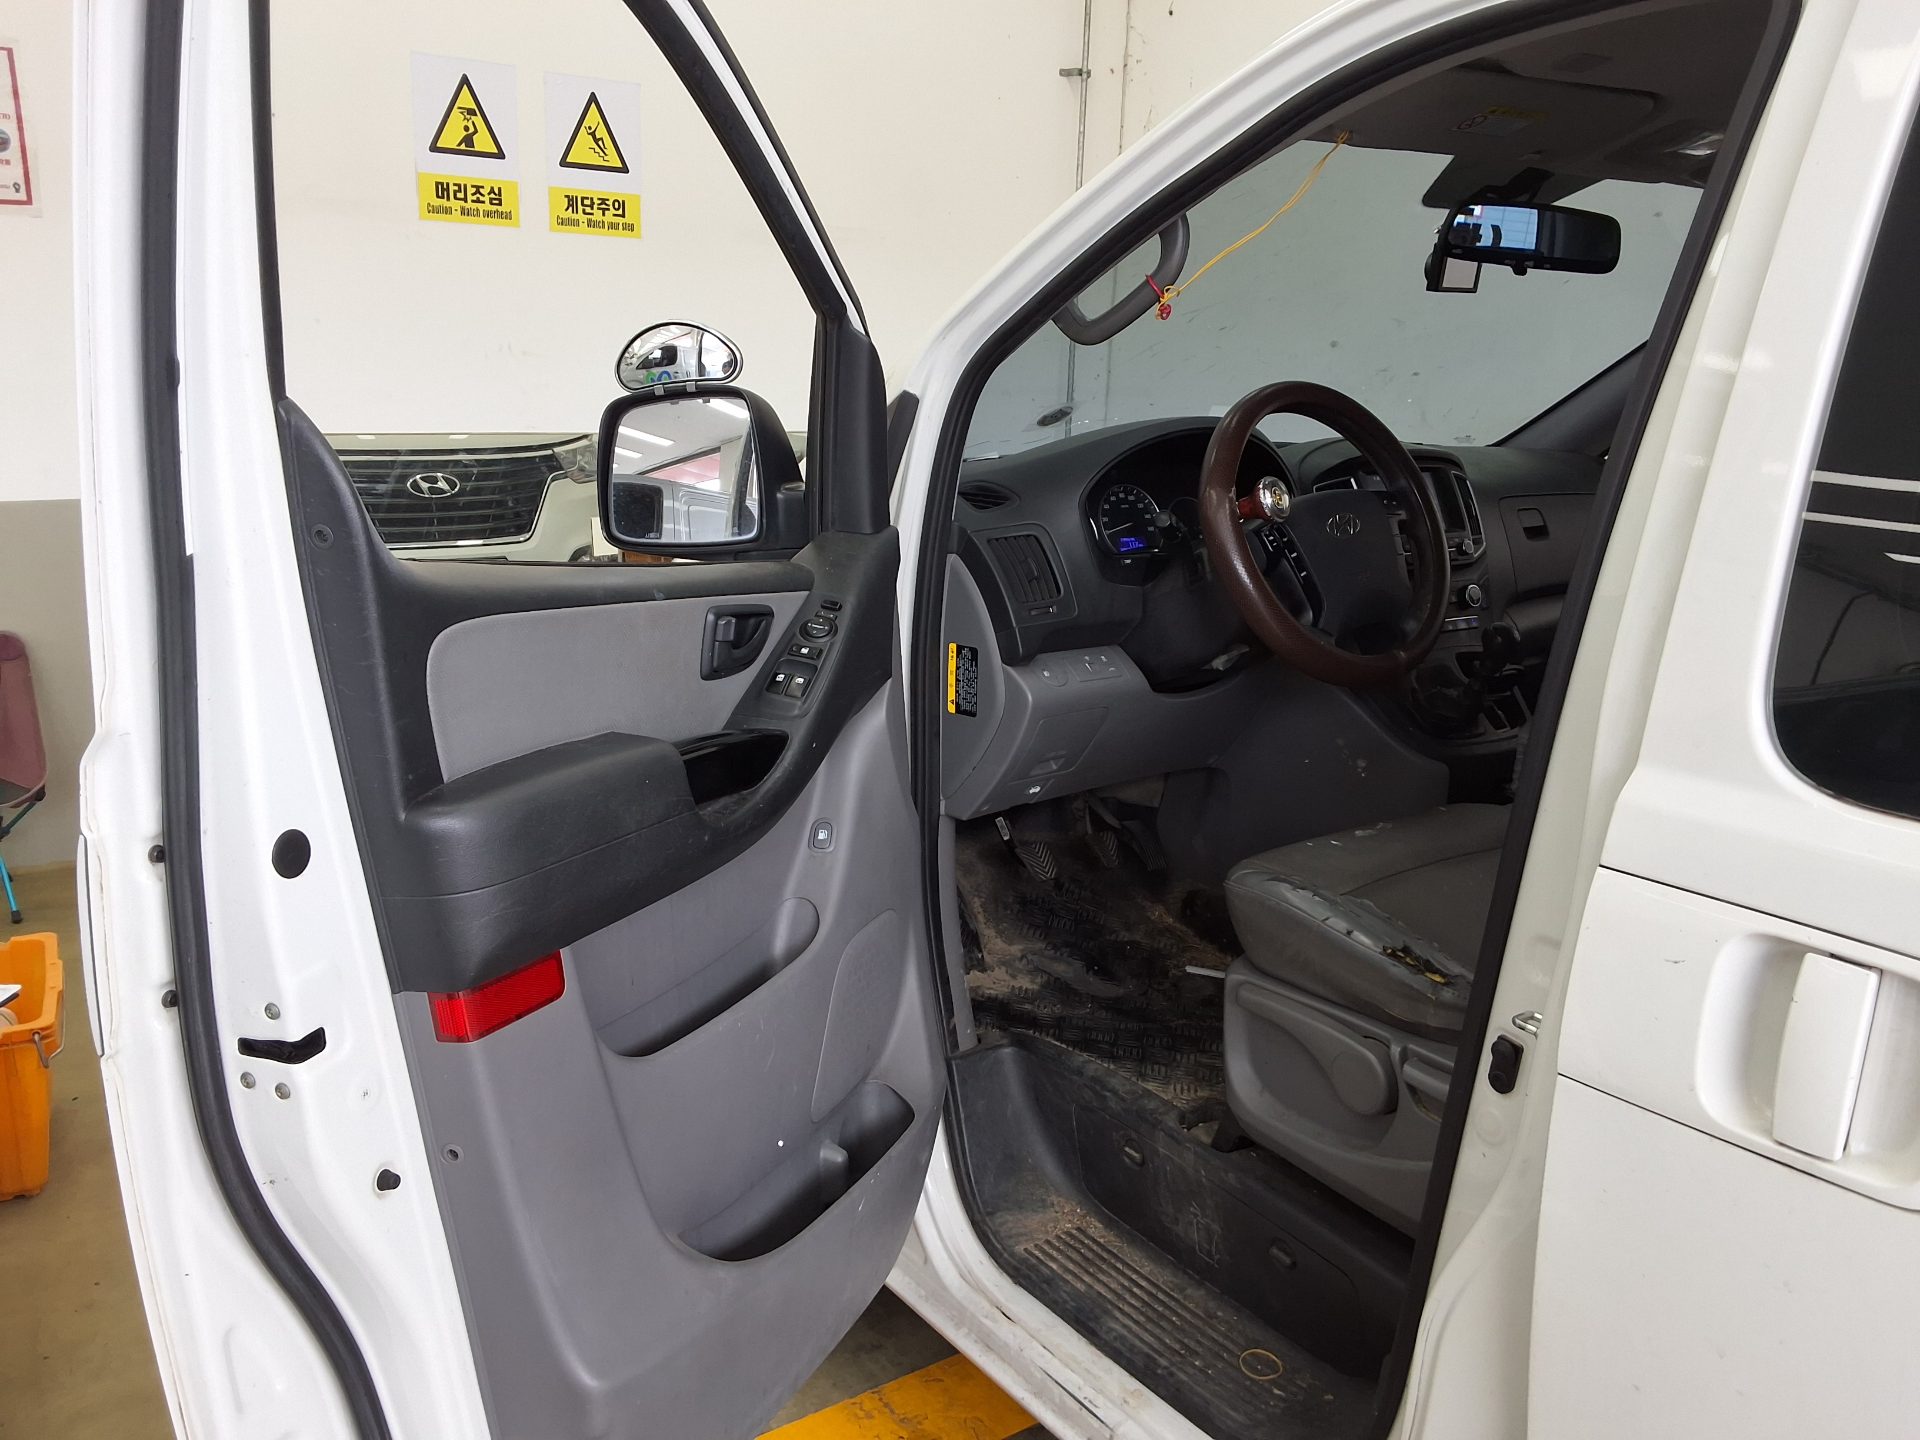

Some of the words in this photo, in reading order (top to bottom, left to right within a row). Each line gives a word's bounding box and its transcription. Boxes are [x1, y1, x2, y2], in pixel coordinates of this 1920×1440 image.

[434, 181, 503, 207] 머리조심
[426, 202, 453, 216] Caution
[459, 205, 481, 218] Watch
[482, 208, 513, 221] overhead
[563, 194, 626, 219] 계단주의
[556, 214, 580, 228] Caution
[586, 217, 606, 230] Watch
[606, 219, 621, 231] your
[621, 221, 635, 233] step
